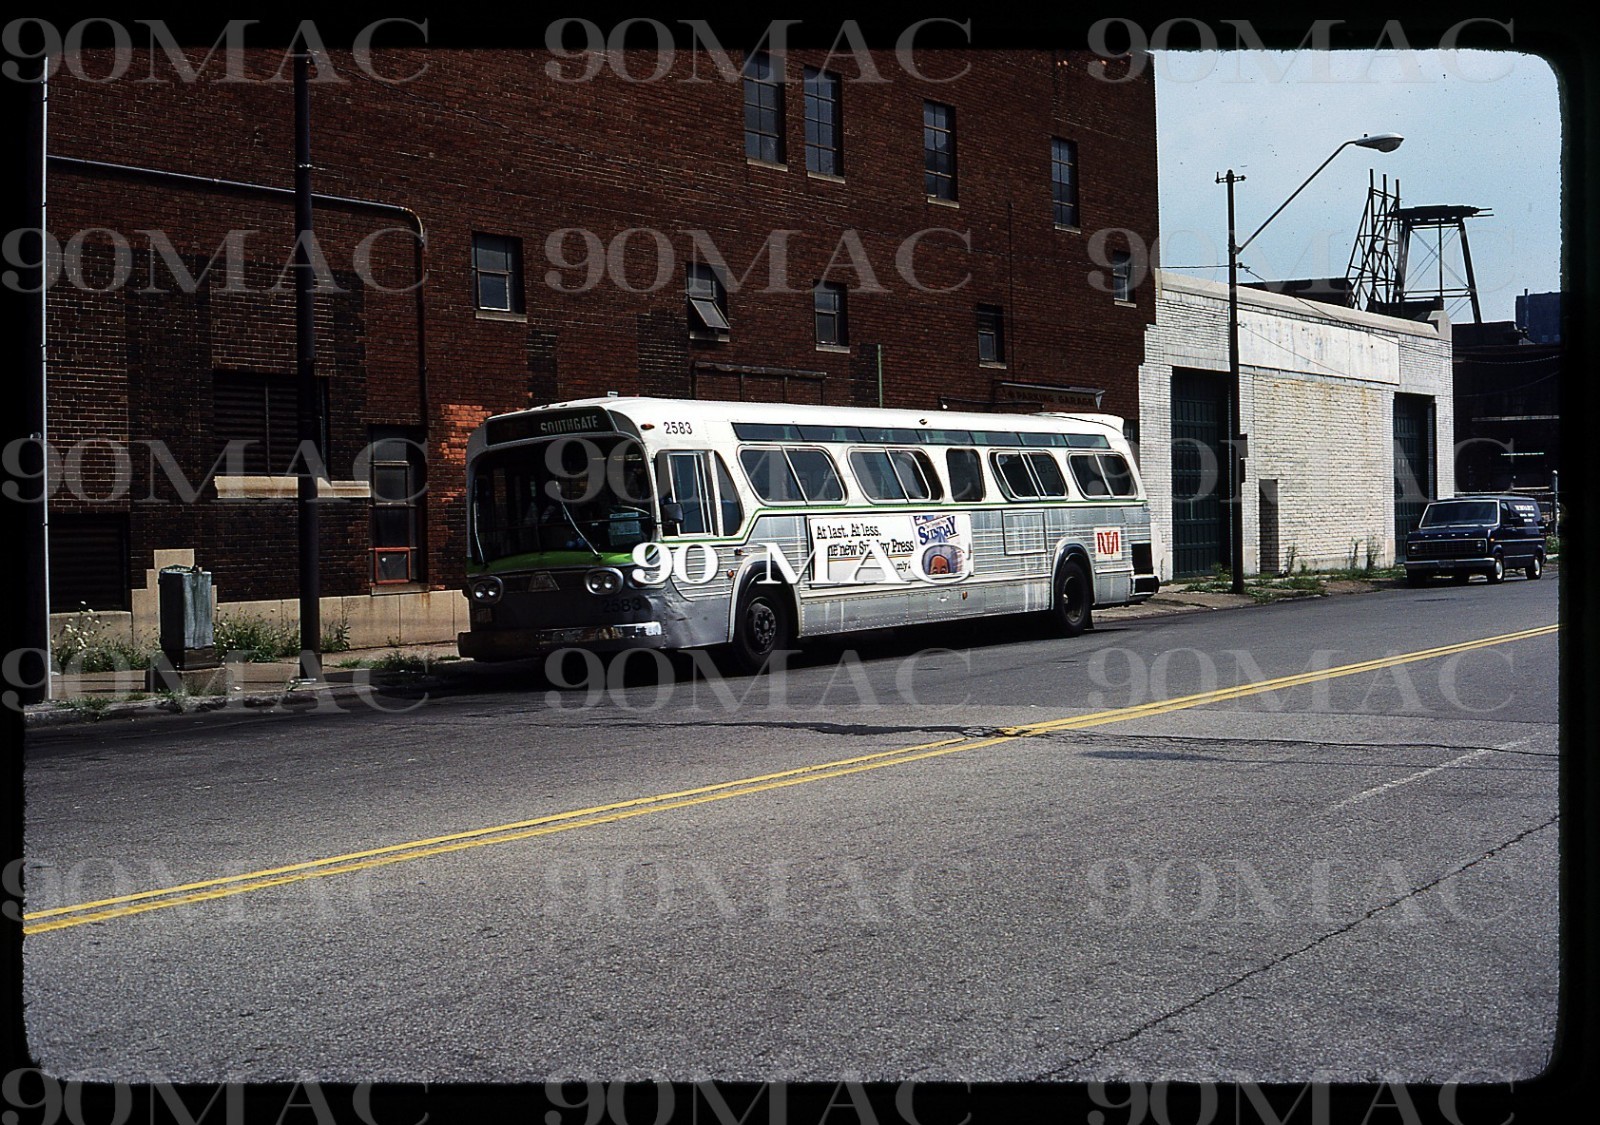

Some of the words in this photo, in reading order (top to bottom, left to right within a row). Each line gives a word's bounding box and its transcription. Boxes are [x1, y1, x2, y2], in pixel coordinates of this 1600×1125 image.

[540, 415, 598, 433] SOUTHGATE
[663, 421, 693, 435] 2583
[816, 526, 828, 540] At
[828, 525, 849, 539] last.
[850, 523, 861, 537] At
[862, 523, 882, 537] less.
[839, 543, 858, 556] new
[892, 538, 914, 553] Press
[602, 598, 642, 613] 2583
